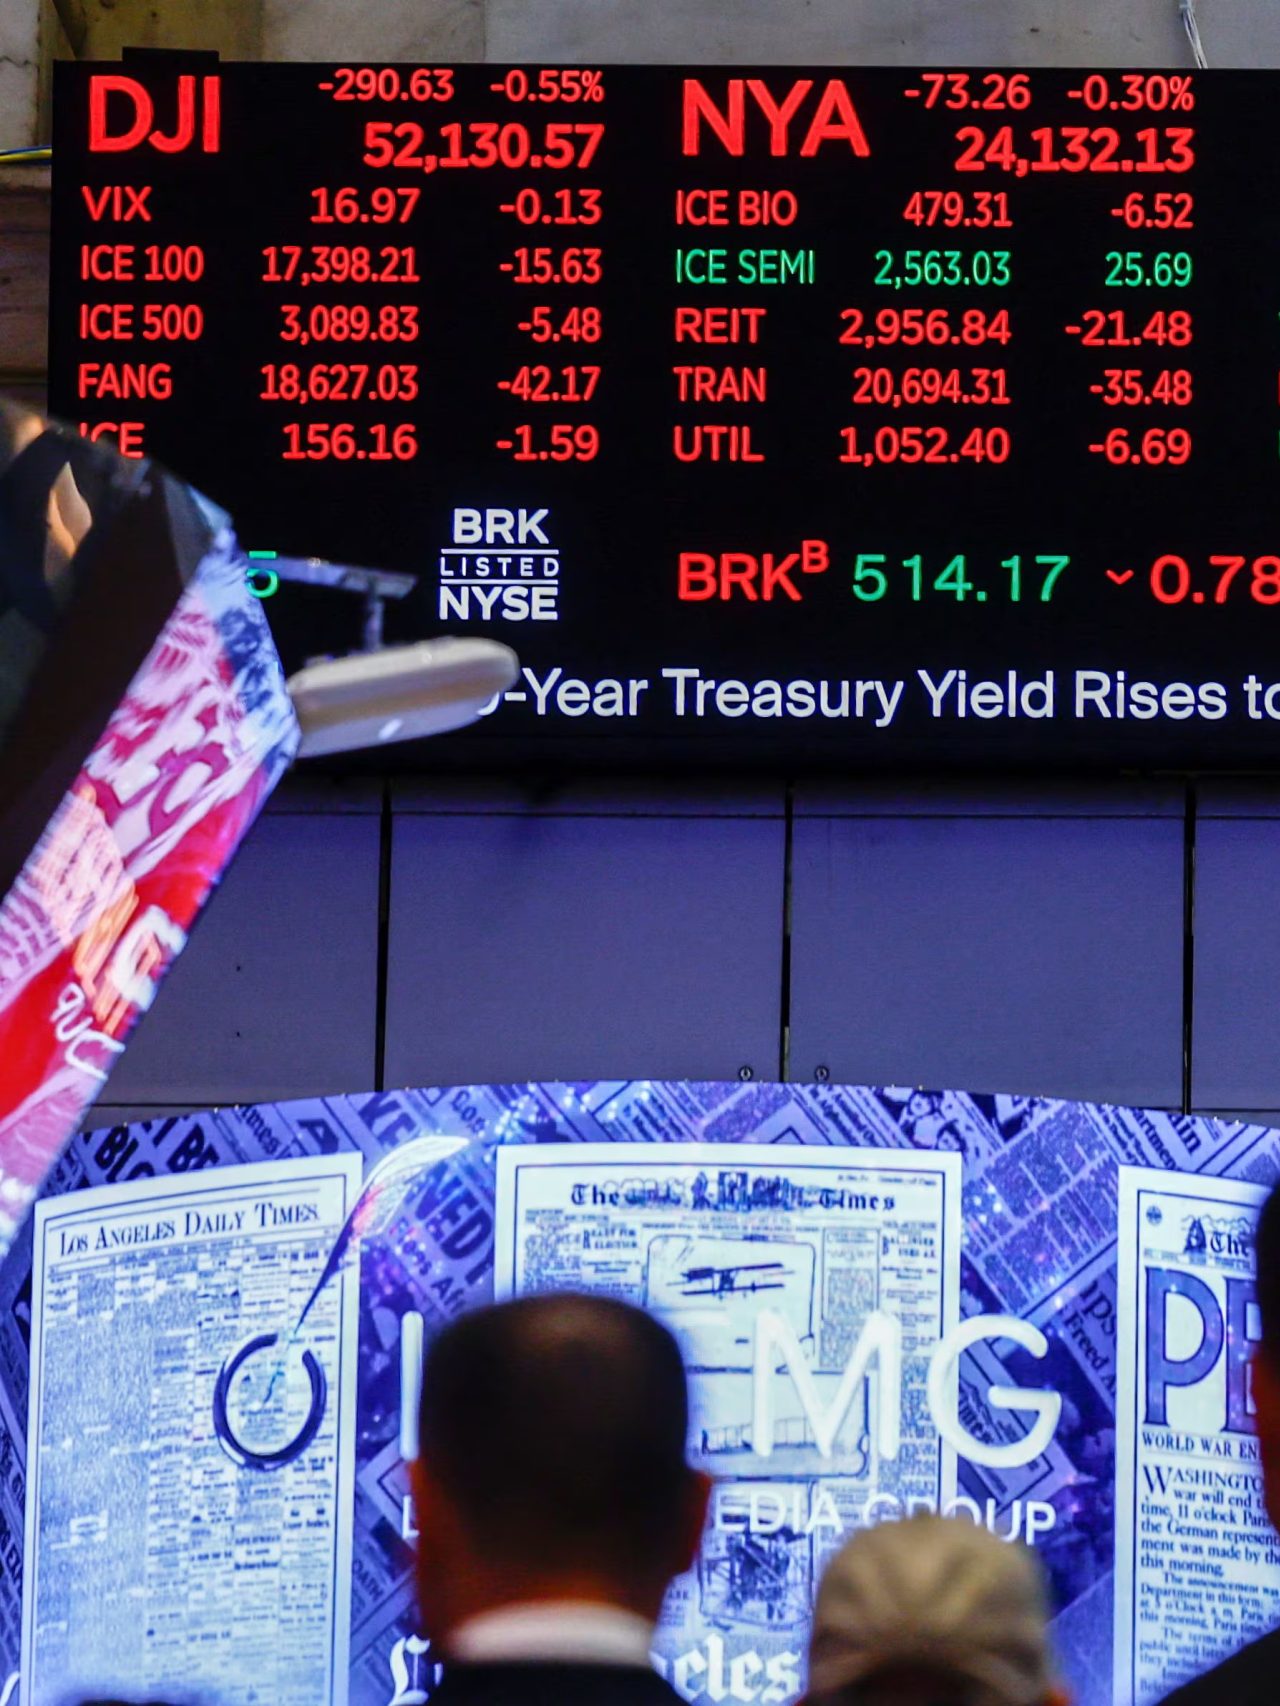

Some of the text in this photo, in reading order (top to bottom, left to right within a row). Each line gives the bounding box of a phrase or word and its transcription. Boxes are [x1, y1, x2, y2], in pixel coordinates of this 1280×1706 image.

[319, 68, 604, 102] -290.63 -0.55%
[904, 74, 1194, 111] -73.26 -0.30%
[89, 75, 220, 153] DJI
[682, 79, 870, 157] NYA
[363, 122, 604, 173] 52,130.57
[955, 126, 1194, 177] 24,132.13
[82, 186, 602, 224] VIX 16.97 -0.13
[676, 189, 1193, 228] ICE BIO 479.31 -6.52
[81, 245, 602, 286] ICE 100 17,398.21 -15.63
[677, 249, 1191, 289] ICE SEMI 2,563.03 25.69
[80, 304, 601, 345] ICE 500 3,089.83 -5.48
[675, 307, 1192, 349] REIT 2,956.84 -21.48
[79, 363, 600, 404] FANG 18,627.03 -42.17
[673, 366, 1192, 408] TRAN 20,694.31 -35.48
[283, 423, 417, 460] 156.16
[496, 425, 599, 461] -1.59
[674, 425, 1191, 467] UTIL 1,052.40 -6.69
[452, 508, 549, 544] BRK
[441, 557, 559, 578] LISTED
[853, 555, 1069, 601] 514.17
[440, 587, 558, 621] NYSE
[478, 668, 648, 717] -Year
[662, 668, 904, 727] Treasury
[917, 670, 1056, 718] Yield
[1075, 670, 1227, 719] Rises
[95, 1219, 175, 1251] ANGELES
[185, 1210, 245, 1237] DAILY
[255, 1201, 319, 1228] TIMES
[1142, 1431, 1258, 1460] WORLD WAR EN
[715, 1489, 842, 1536] EDIA
[1202, 1491, 1224, 1505] will
[1229, 1494, 1252, 1509] end
[1141, 1520, 1162, 1533] the
[1167, 1519, 1219, 1540] German
[1141, 1538, 1174, 1551] ment
[1180, 1542, 1203, 1555] was
[1208, 1545, 1241, 1560] made
[1245, 1546, 1260, 1565] by
[1141, 1553, 1164, 1569] this
[650, 1633, 803, 1704] eles
